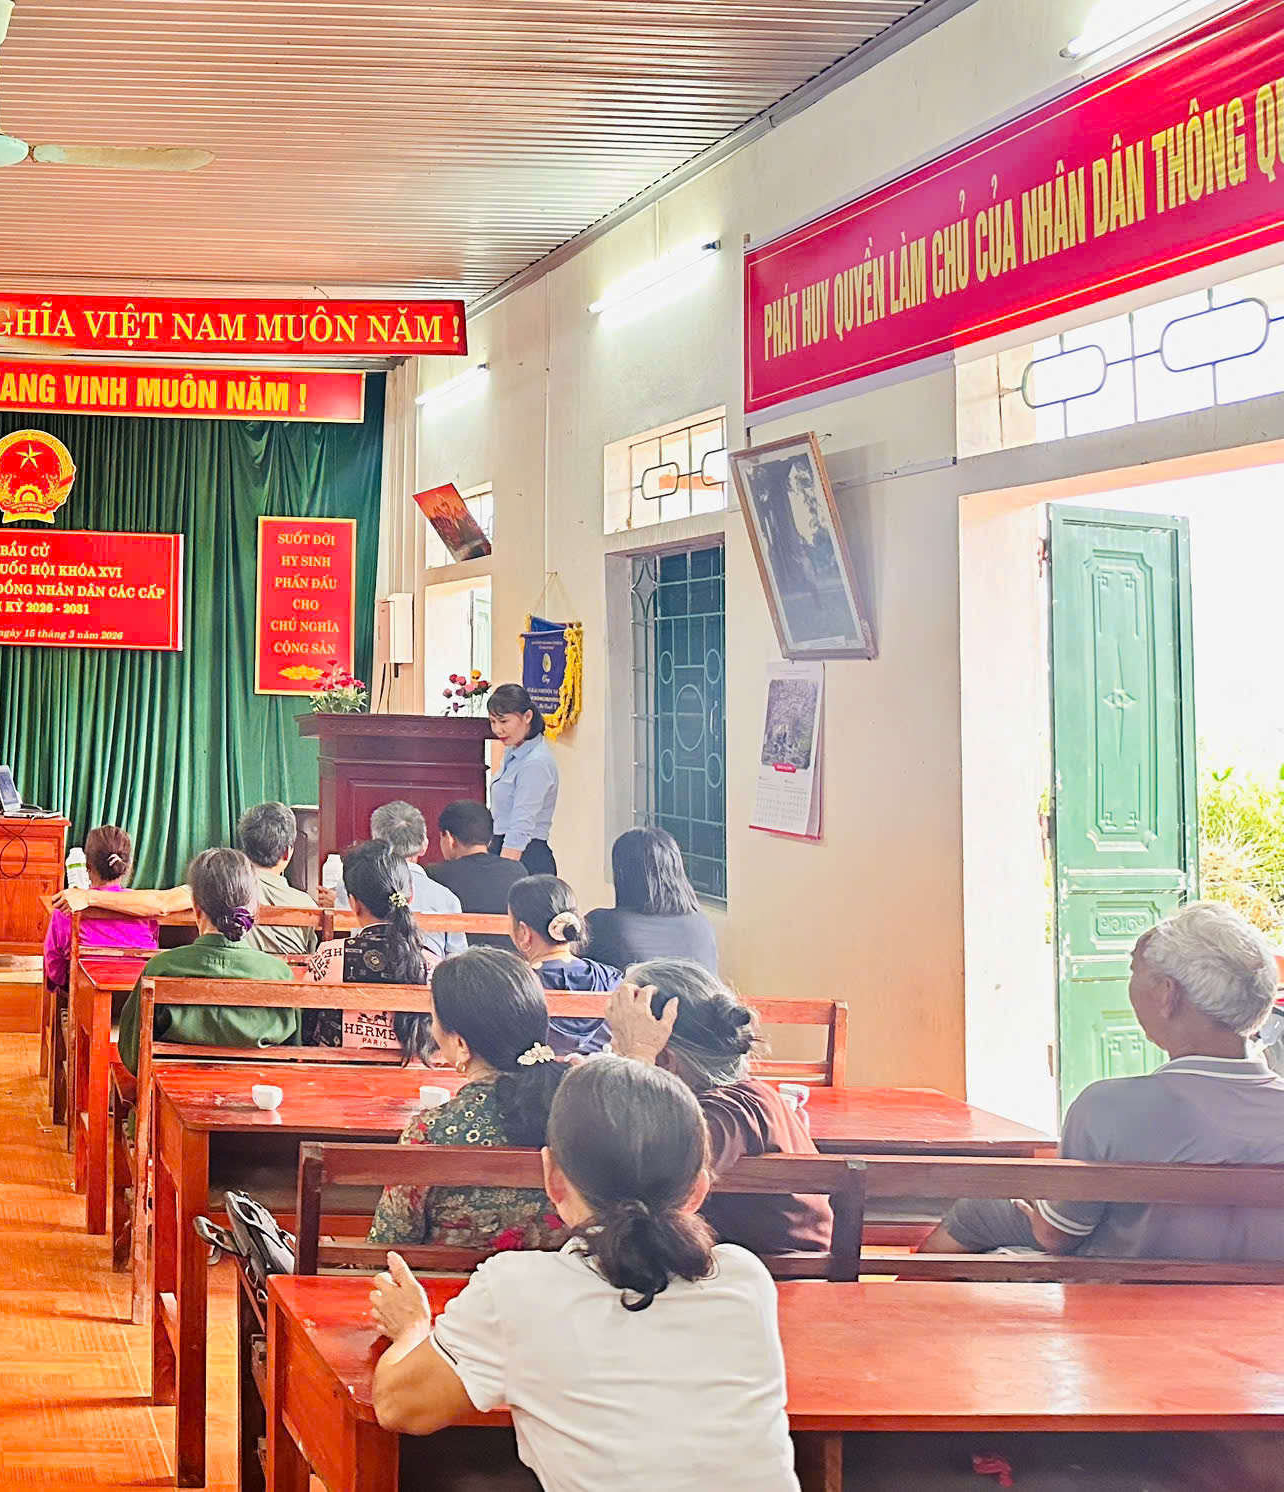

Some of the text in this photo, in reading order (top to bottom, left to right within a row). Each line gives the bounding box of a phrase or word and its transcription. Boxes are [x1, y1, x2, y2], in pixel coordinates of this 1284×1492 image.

[764, 283, 797, 361] PHÁT
[801, 278, 830, 348] HUY
[832, 236, 885, 342] QUYỀN
[890, 230, 927, 315] LÀM
[931, 188, 969, 300] CHỦ
[976, 174, 1017, 279] CỦA
[1021, 159, 1086, 265] NHÂN
[1093, 134, 1146, 238] DÂN
[1151, 98, 1247, 214] THÔNG
[83, 305, 163, 347] VIỆT
[173, 312, 247, 343] NAM
[255, 310, 358, 344] MUÔN
[366, 314, 443, 344] NĂM
[452, 315, 460, 344] !
[64, 373, 127, 406] VINH
[135, 373, 217, 410] MUÔN
[226, 375, 290, 412] NĂM
[299, 383, 307, 412] !
[277, 529, 335, 546] SUỐT ĐỜI
[30, 541, 51, 557] CỬ
[31, 561, 55, 579] HỘI
[58, 563, 97, 577] KHÓA
[98, 566, 123, 578] XVI
[281, 556, 331, 568] HY SINH
[36, 582, 74, 597] NHÂN
[77, 583, 105, 598] DÂN
[108, 584, 135, 598] CÁC
[138, 584, 165, 599] CẤP
[276, 574, 337, 590] PHẤN ĐẤU
[5, 598, 24, 612] KỲ
[26, 602, 53, 613] 2026
[63, 604, 90, 615] 2031
[292, 599, 319, 611] CHO
[270, 617, 340, 633] CHỦ NGHĨA
[274, 641, 336, 657] CỘNG SẢN
[344, 1023, 396, 1041] HERME
[362, 1037, 388, 1047] PARIS
